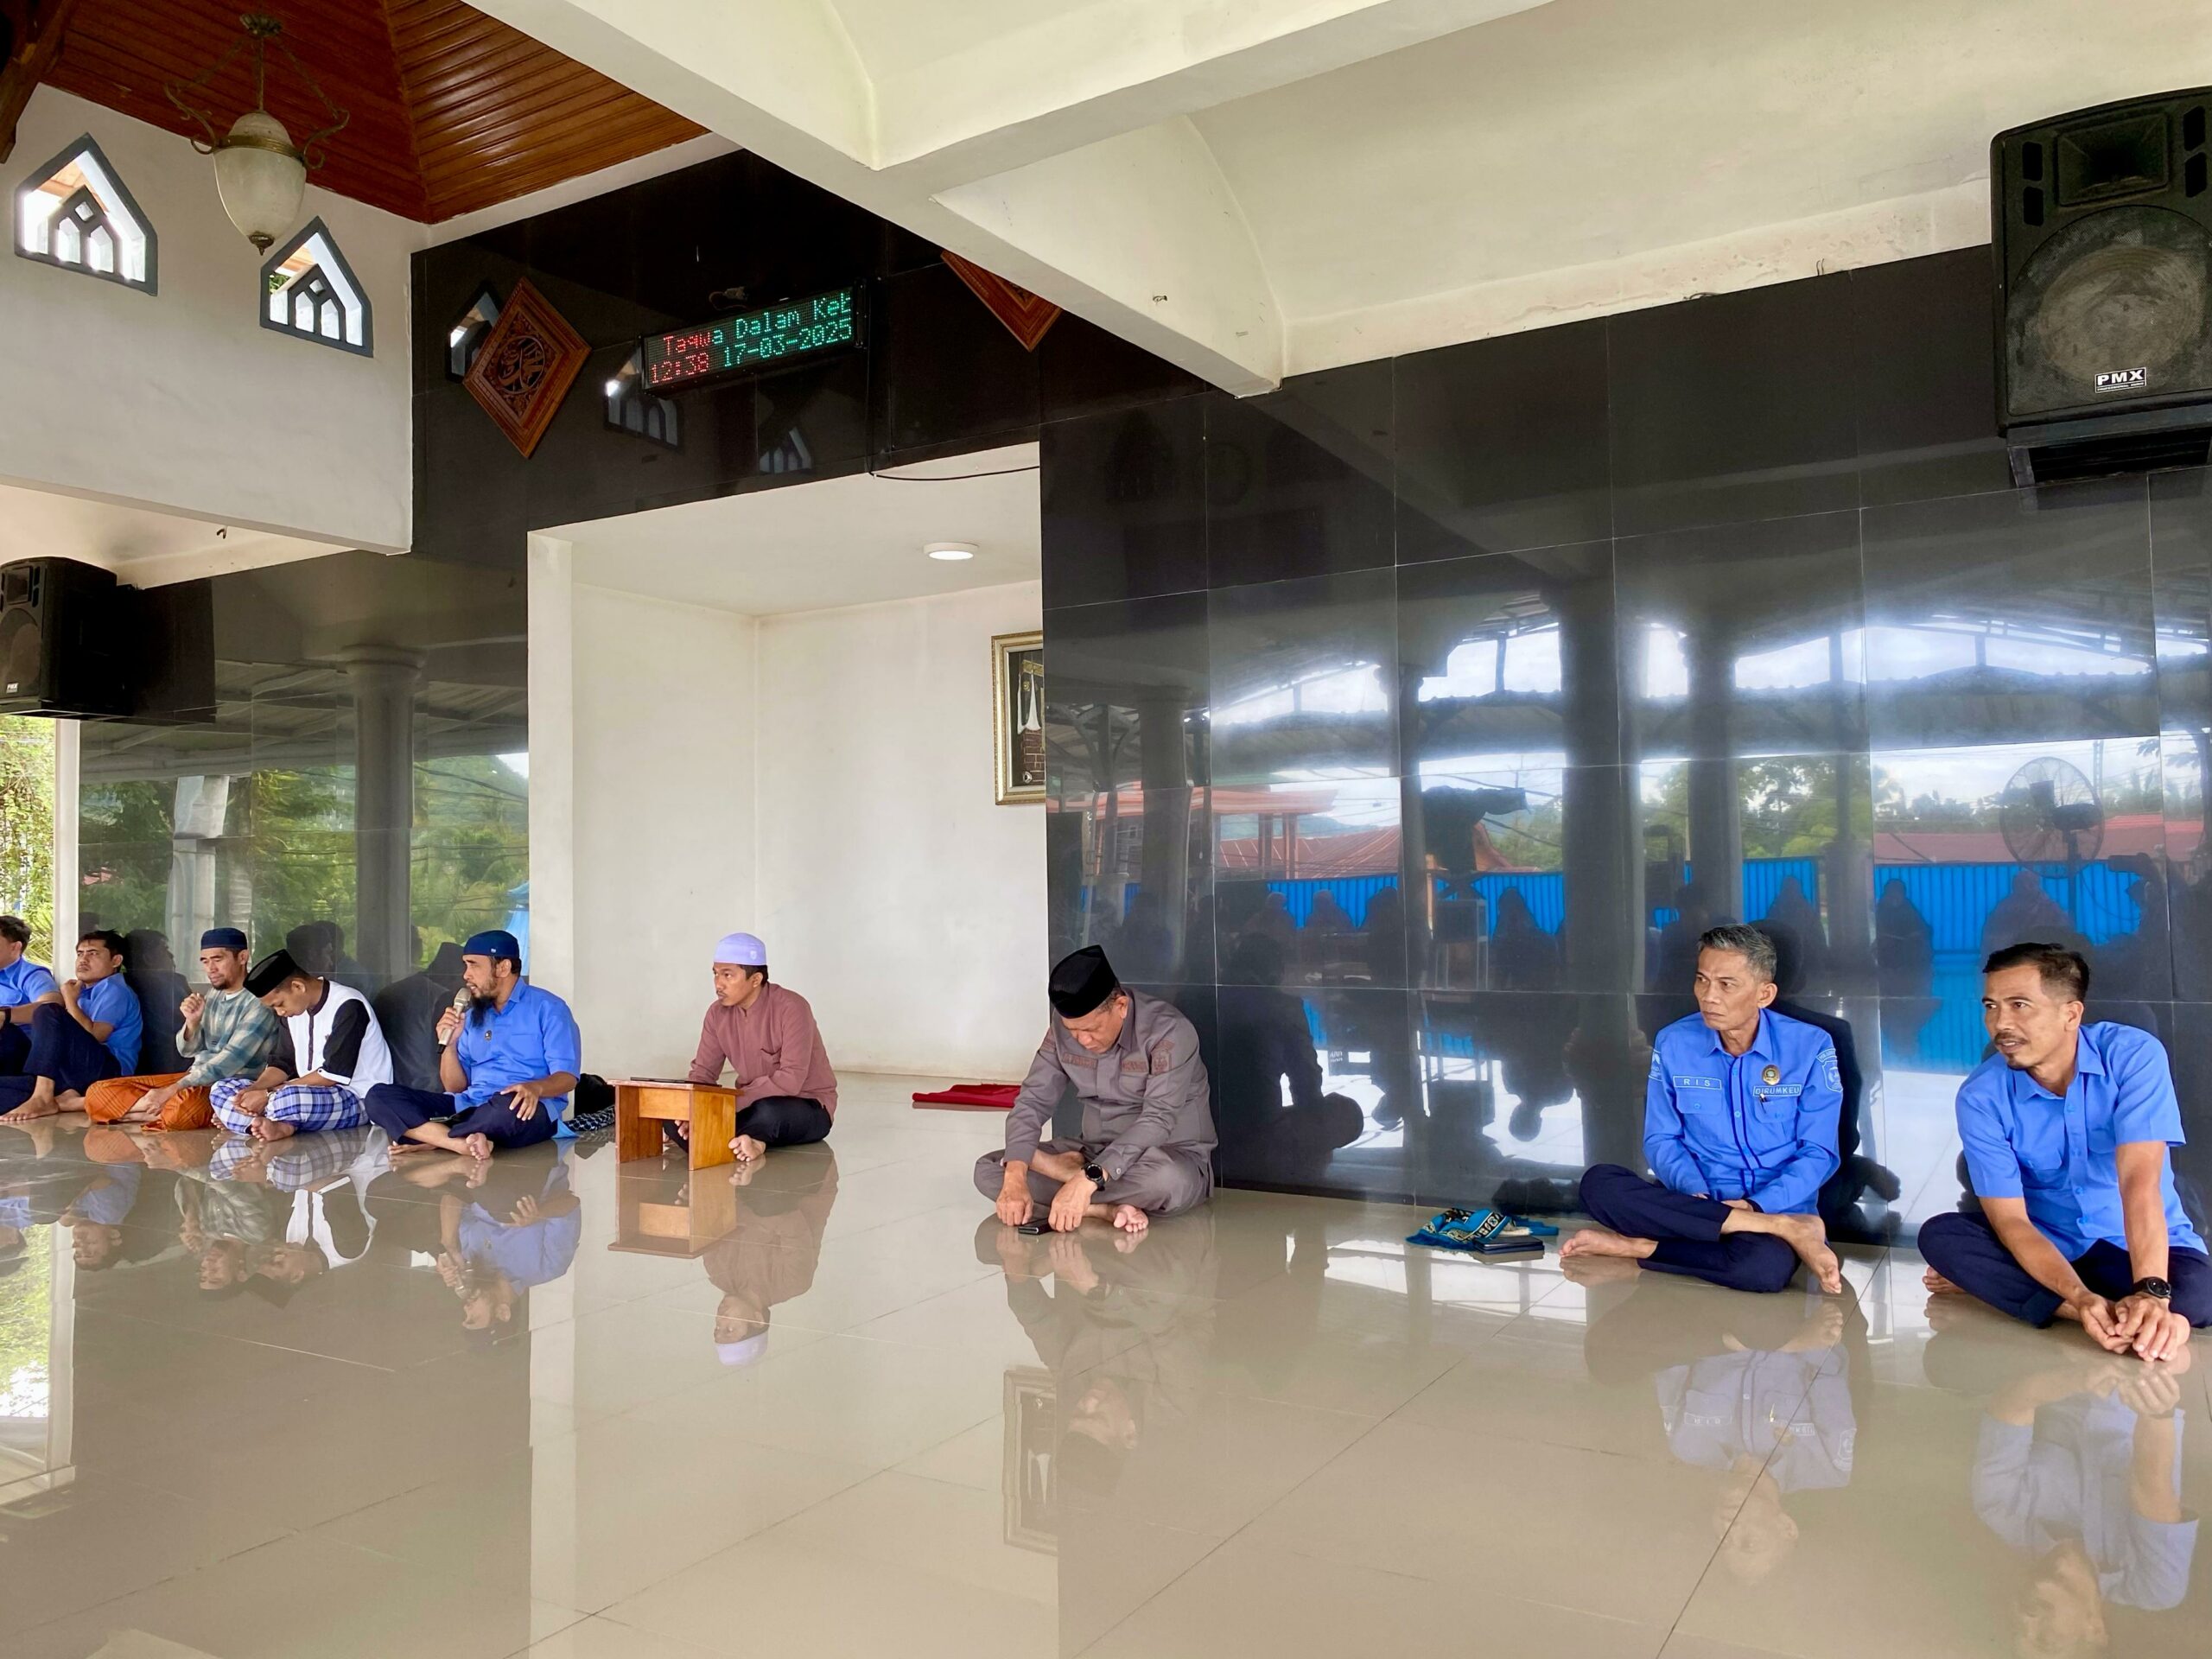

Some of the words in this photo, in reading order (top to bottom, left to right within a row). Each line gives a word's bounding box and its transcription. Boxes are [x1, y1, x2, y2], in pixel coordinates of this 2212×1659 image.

[652, 352, 709, 384] 12:38
[724, 317, 852, 367] 17-03-2025
[663, 329, 723, 357] Taqwa
[735, 310, 800, 339] Dalam
[813, 292, 852, 321] Ket
[2097, 369, 2144, 386] PMX
